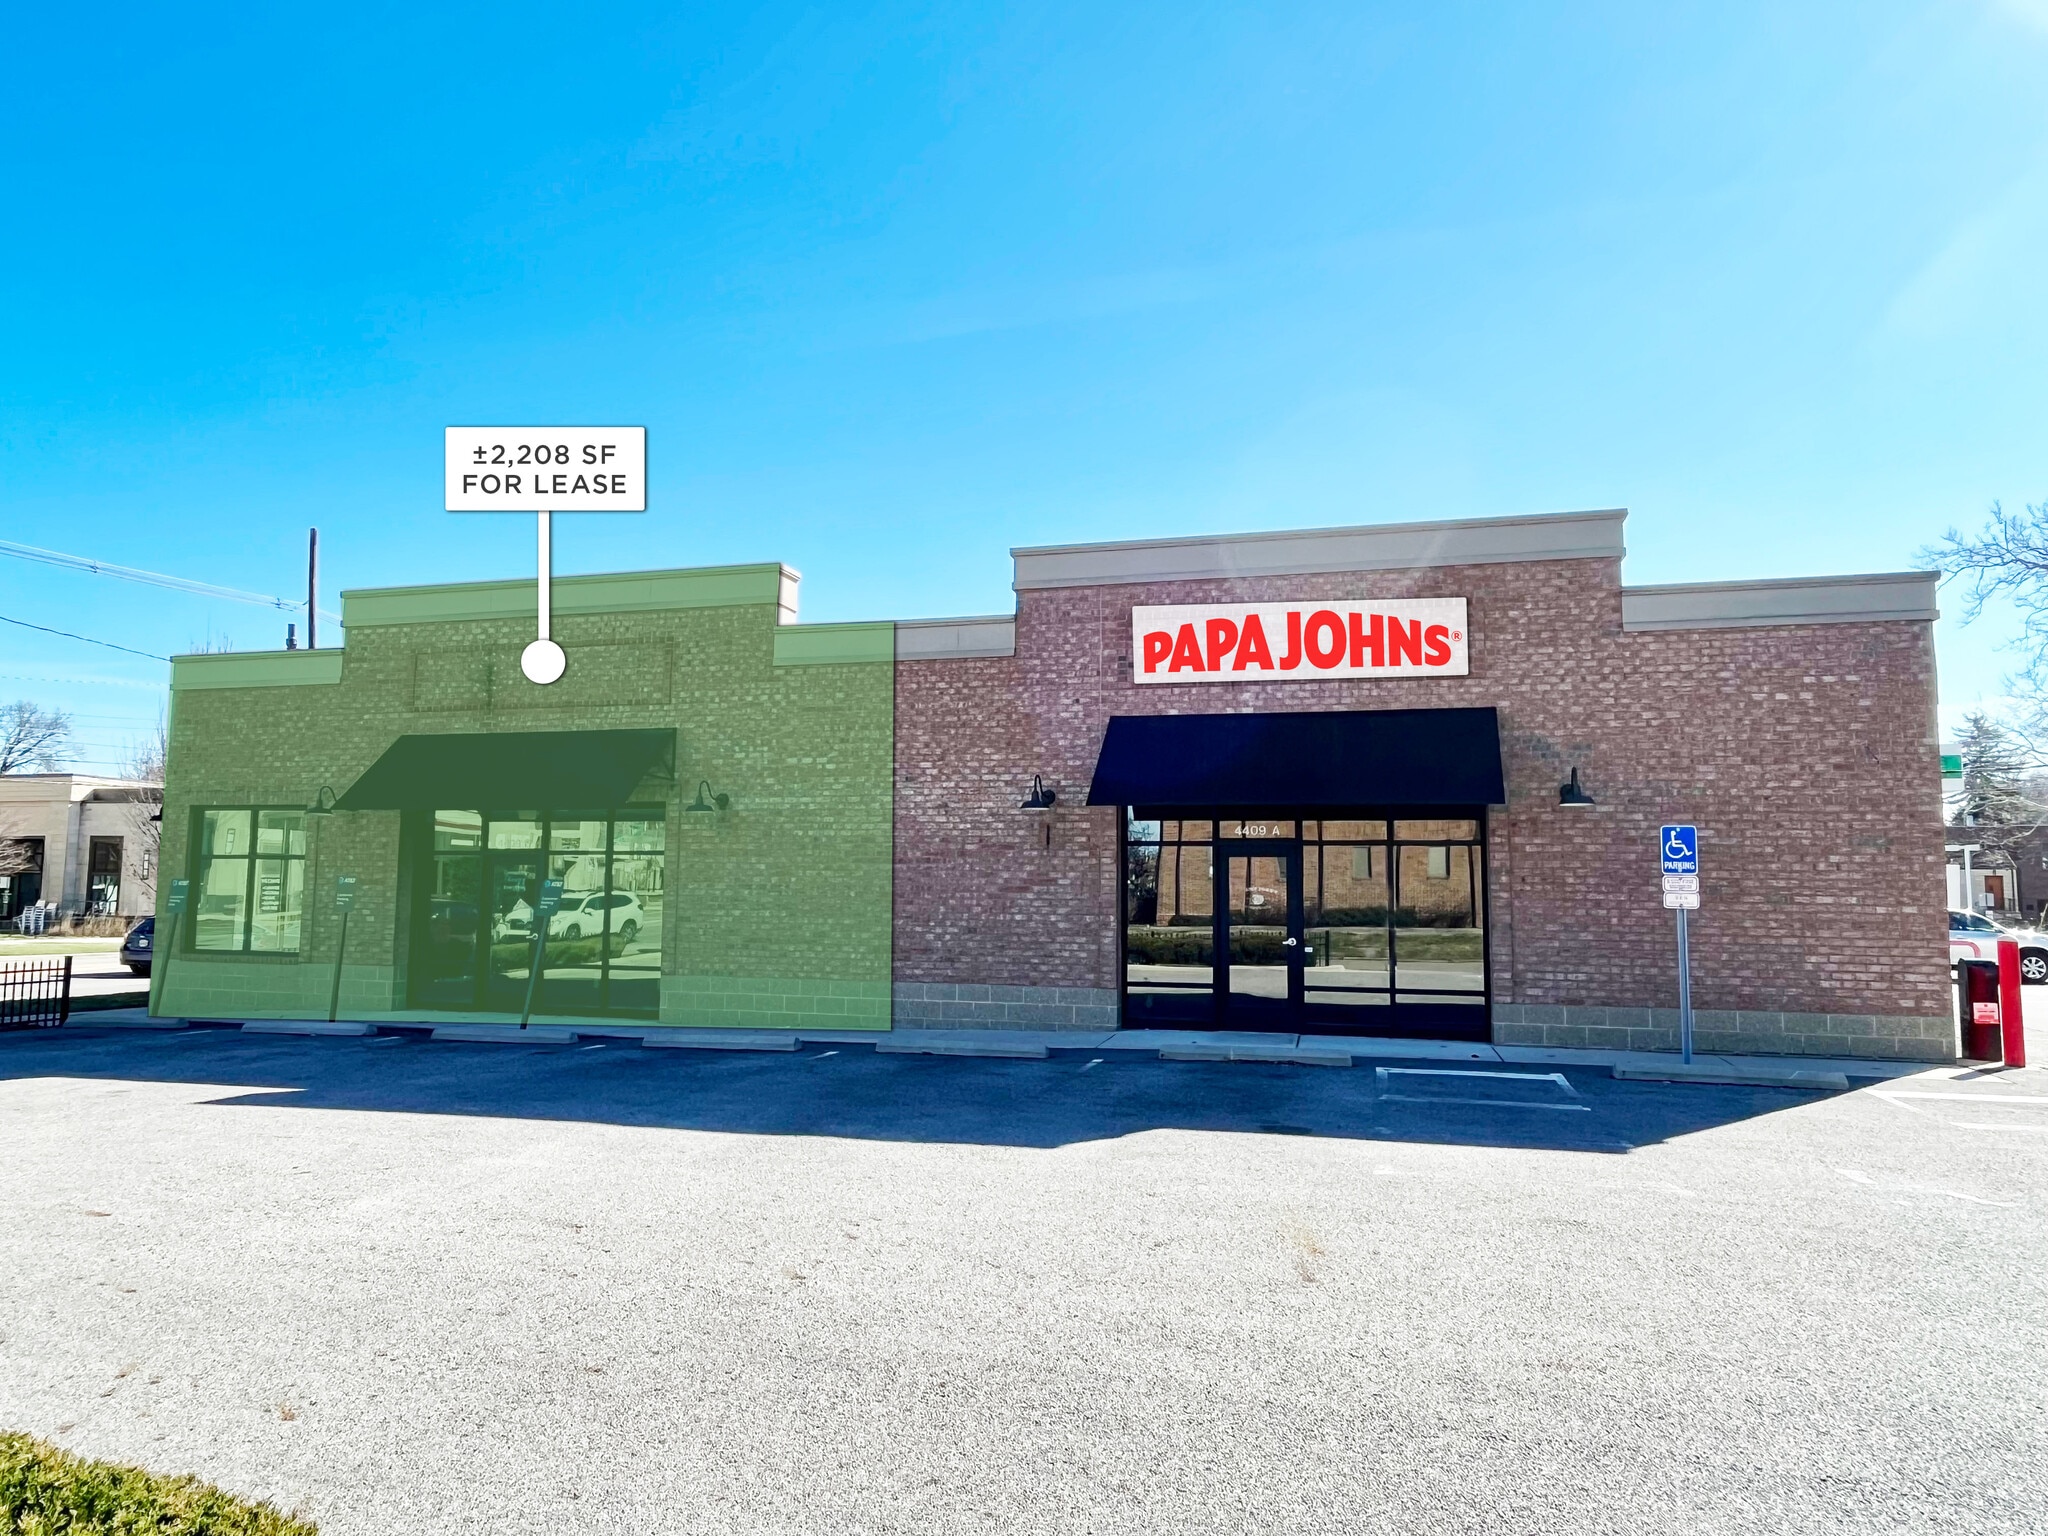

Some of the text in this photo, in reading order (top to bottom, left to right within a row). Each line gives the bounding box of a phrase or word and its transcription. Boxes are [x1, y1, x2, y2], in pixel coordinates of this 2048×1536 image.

[1143, 614, 1275, 673] PAPA
[1234, 825, 1280, 836] 4409 A
[1664, 861, 1696, 870] PARKING
